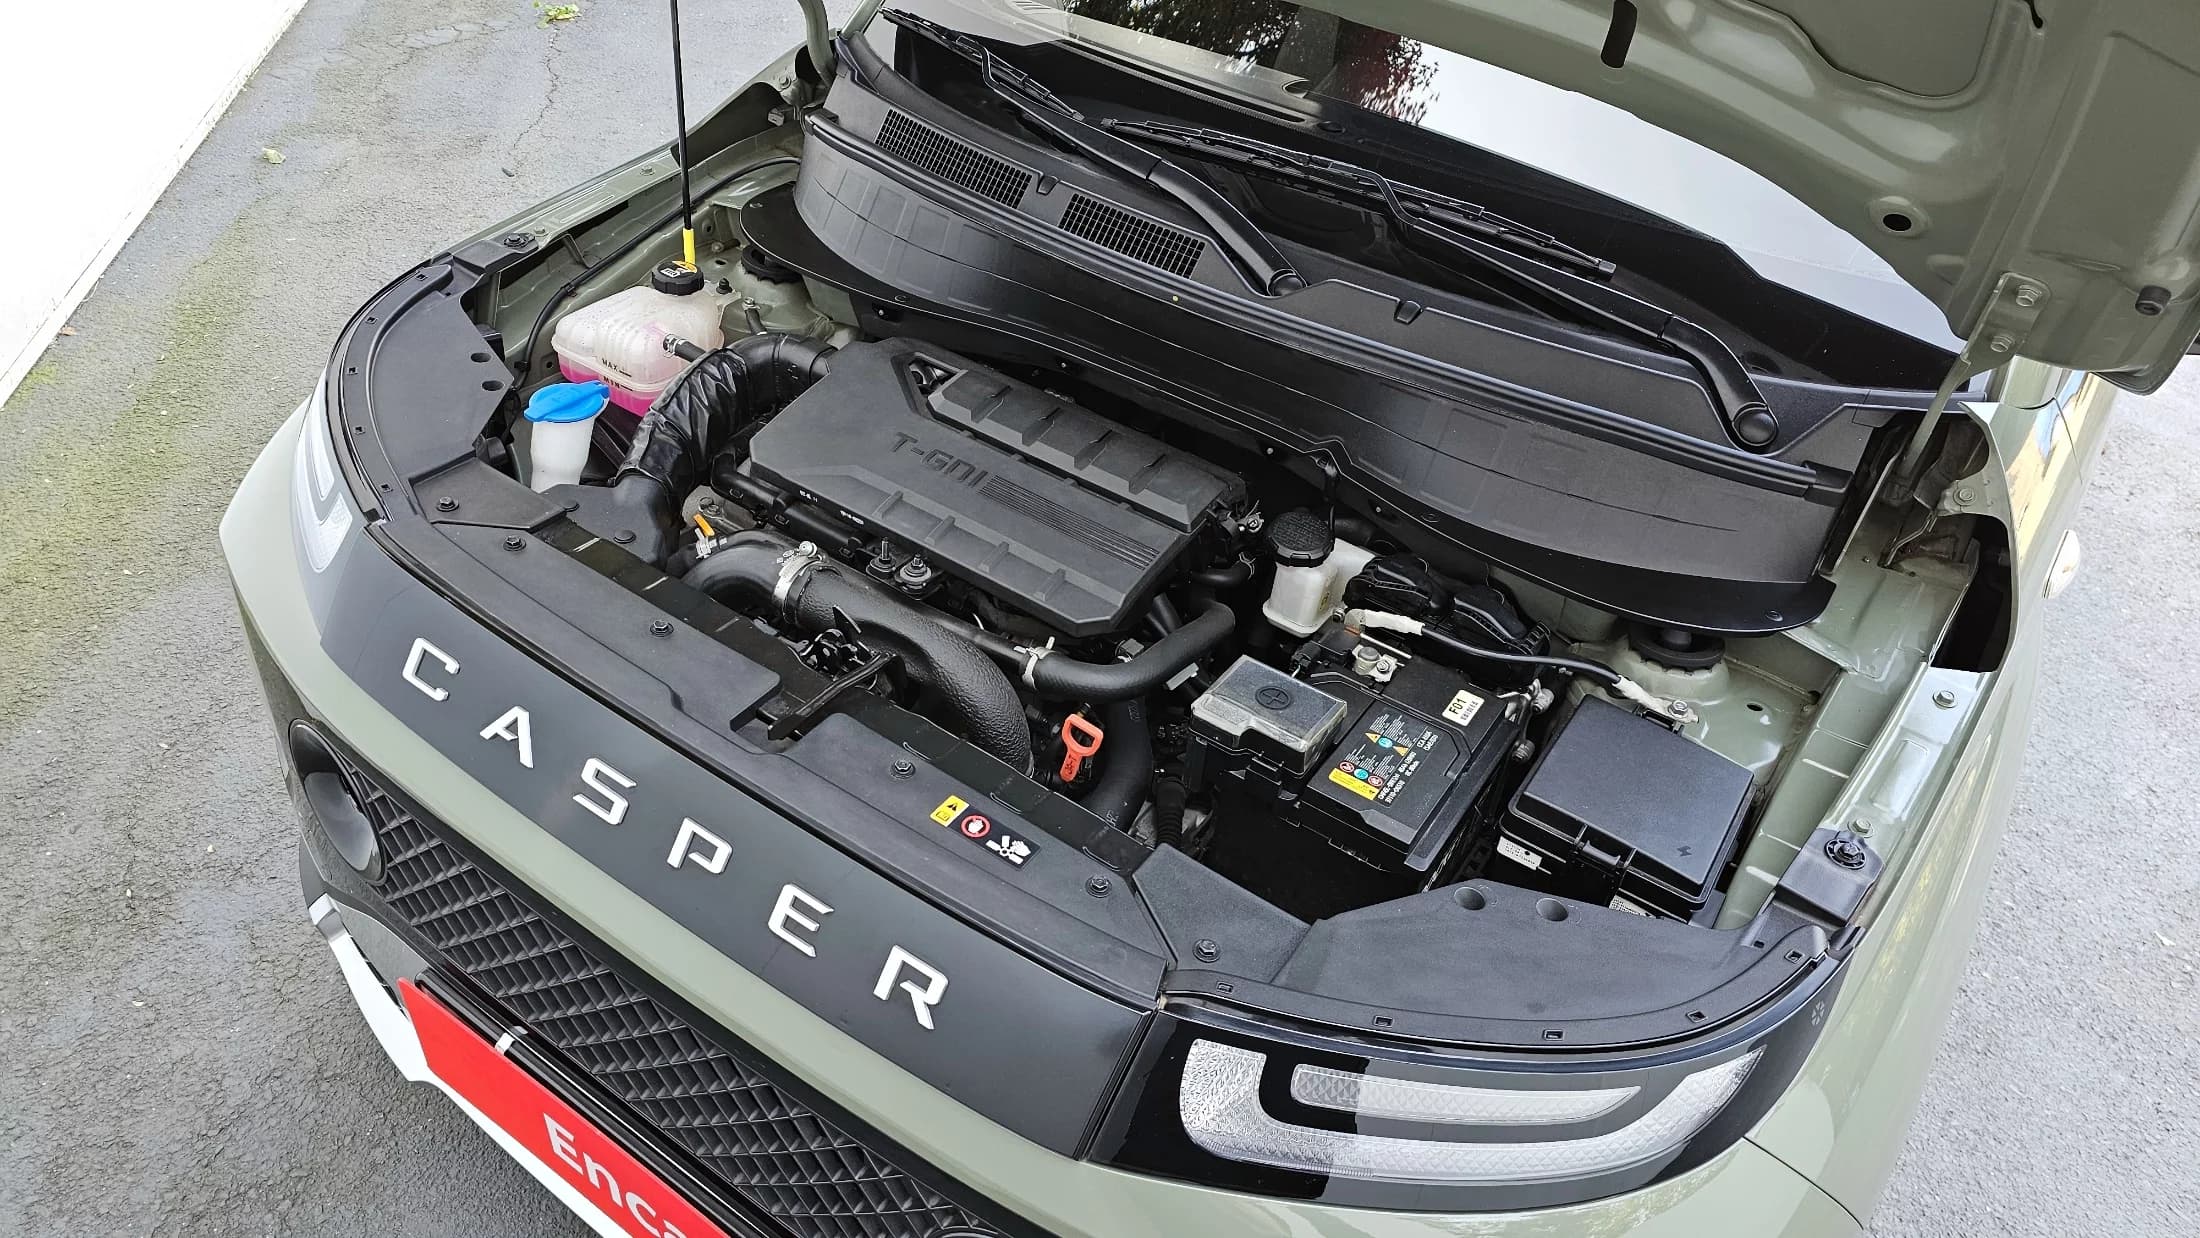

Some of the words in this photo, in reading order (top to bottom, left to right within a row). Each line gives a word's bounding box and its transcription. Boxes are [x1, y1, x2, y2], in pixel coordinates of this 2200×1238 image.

[601, 357, 618, 372] MAX
[603, 375, 620, 389] MIN
[890, 431, 989, 489] T-GDI
[1448, 697, 1467, 715] F01
[402, 637, 950, 1030] CASPER
